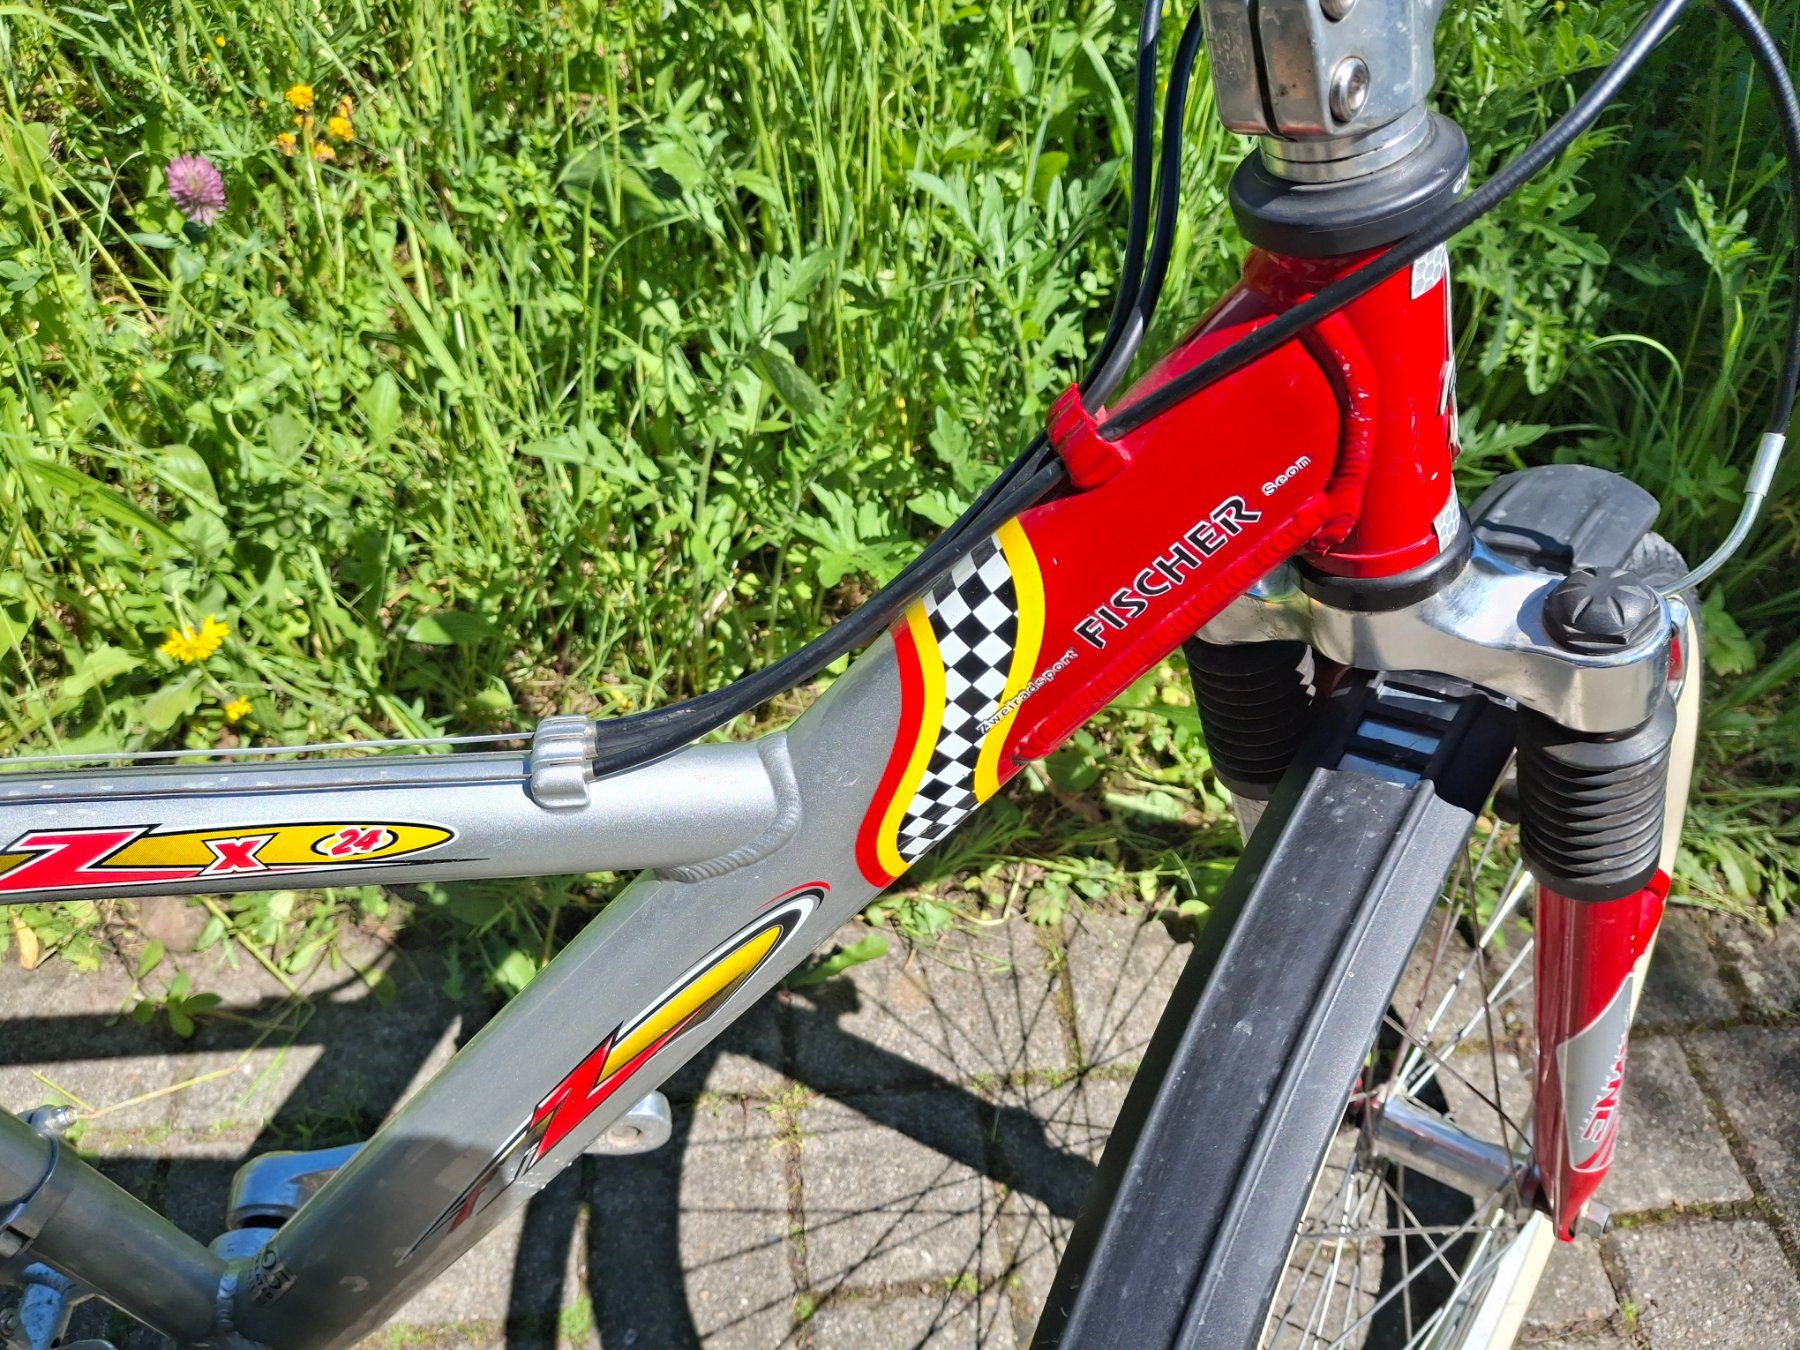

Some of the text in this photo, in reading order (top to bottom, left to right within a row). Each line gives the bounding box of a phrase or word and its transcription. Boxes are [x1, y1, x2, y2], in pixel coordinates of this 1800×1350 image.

[976, 455, 1312, 735] Zweiradsport FISCHER Seon
[329, 826, 387, 857] 24
